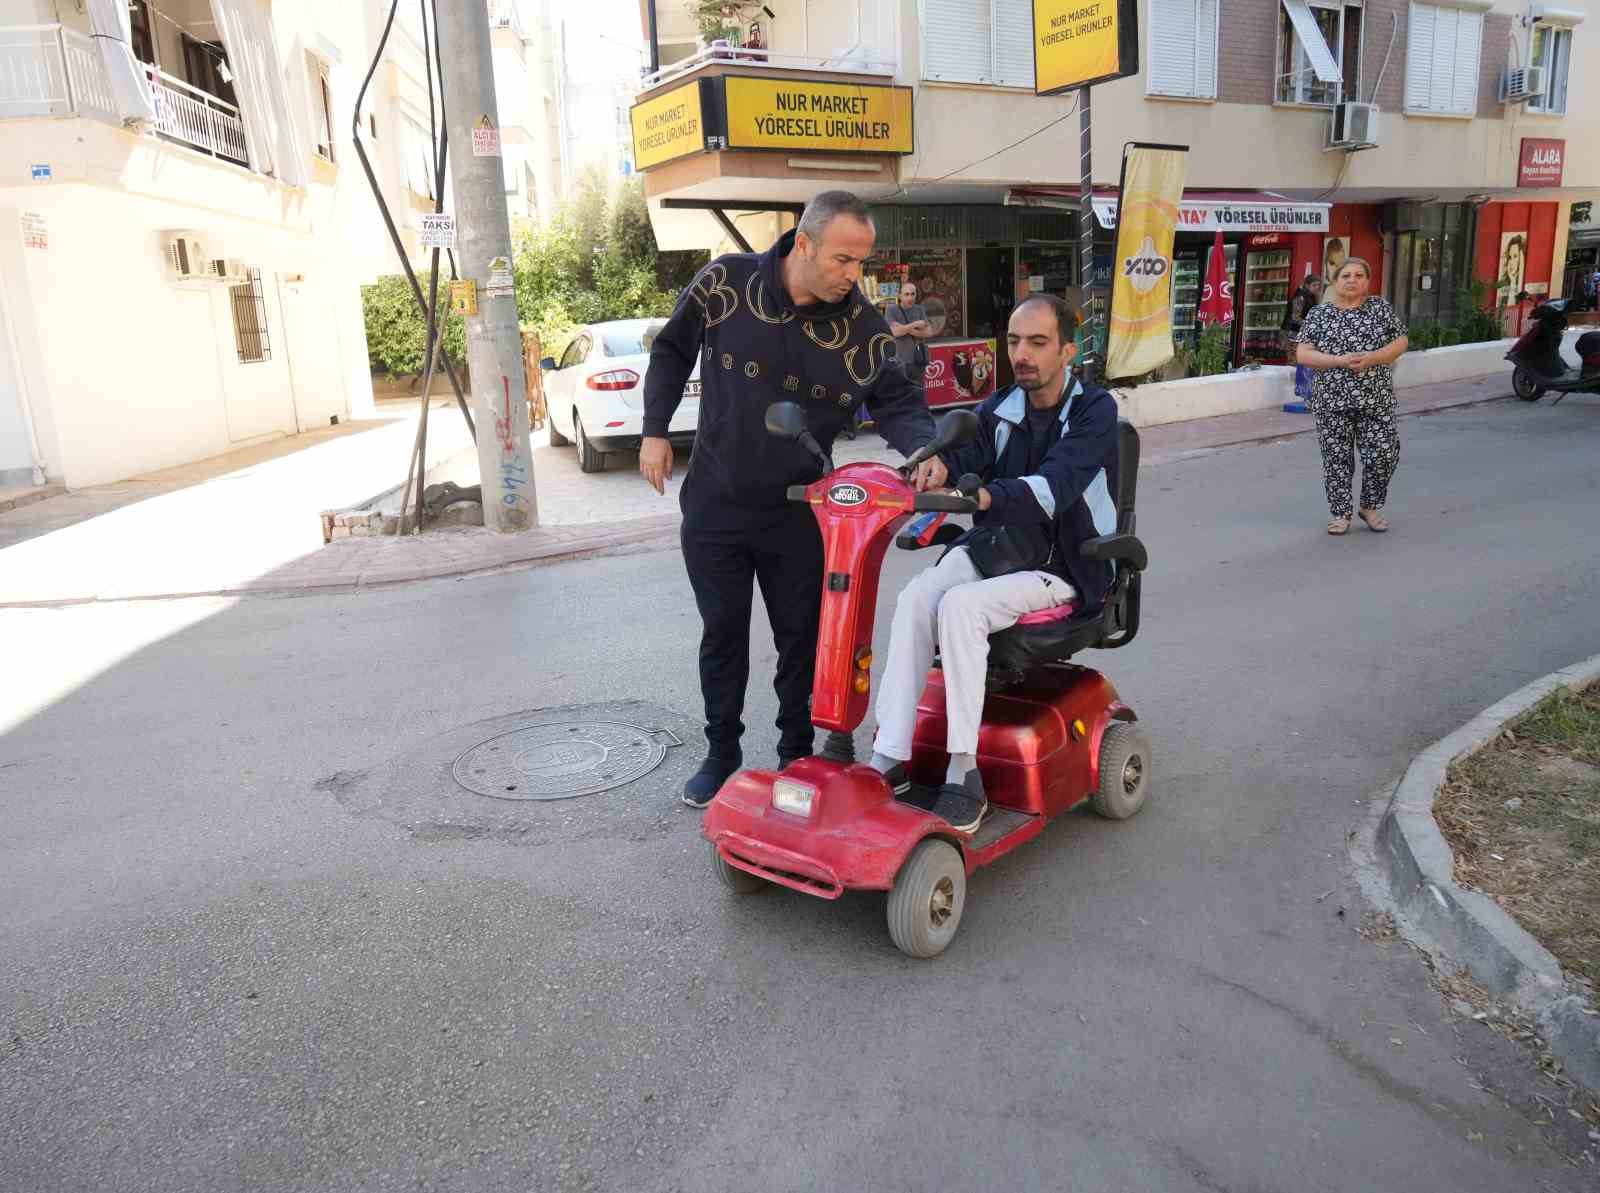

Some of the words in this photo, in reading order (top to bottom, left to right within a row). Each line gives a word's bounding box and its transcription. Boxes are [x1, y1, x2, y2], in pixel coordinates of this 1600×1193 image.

[1050, 15, 1067, 29] NUR
[1068, 4, 1100, 24] MARKET
[1041, 28, 1075, 47] YÖRESEL
[1075, 15, 1113, 37] ÜRÜNLER
[776, 92, 807, 112] NUR
[811, 95, 868, 114] MARKET
[645, 115, 659, 130] NUR
[659, 103, 685, 123] MARKET
[755, 113, 822, 137] YÖRESEL
[825, 115, 890, 140] ÜRÜNLER
[639, 131, 666, 152] YÖRESEL
[666, 119, 698, 143] ÜRÜNLER
[1531, 149, 1561, 164] ALARA
[1215, 206, 1268, 224] YÖRESEL
[1270, 208, 1322, 225] ÜRÜNLER
